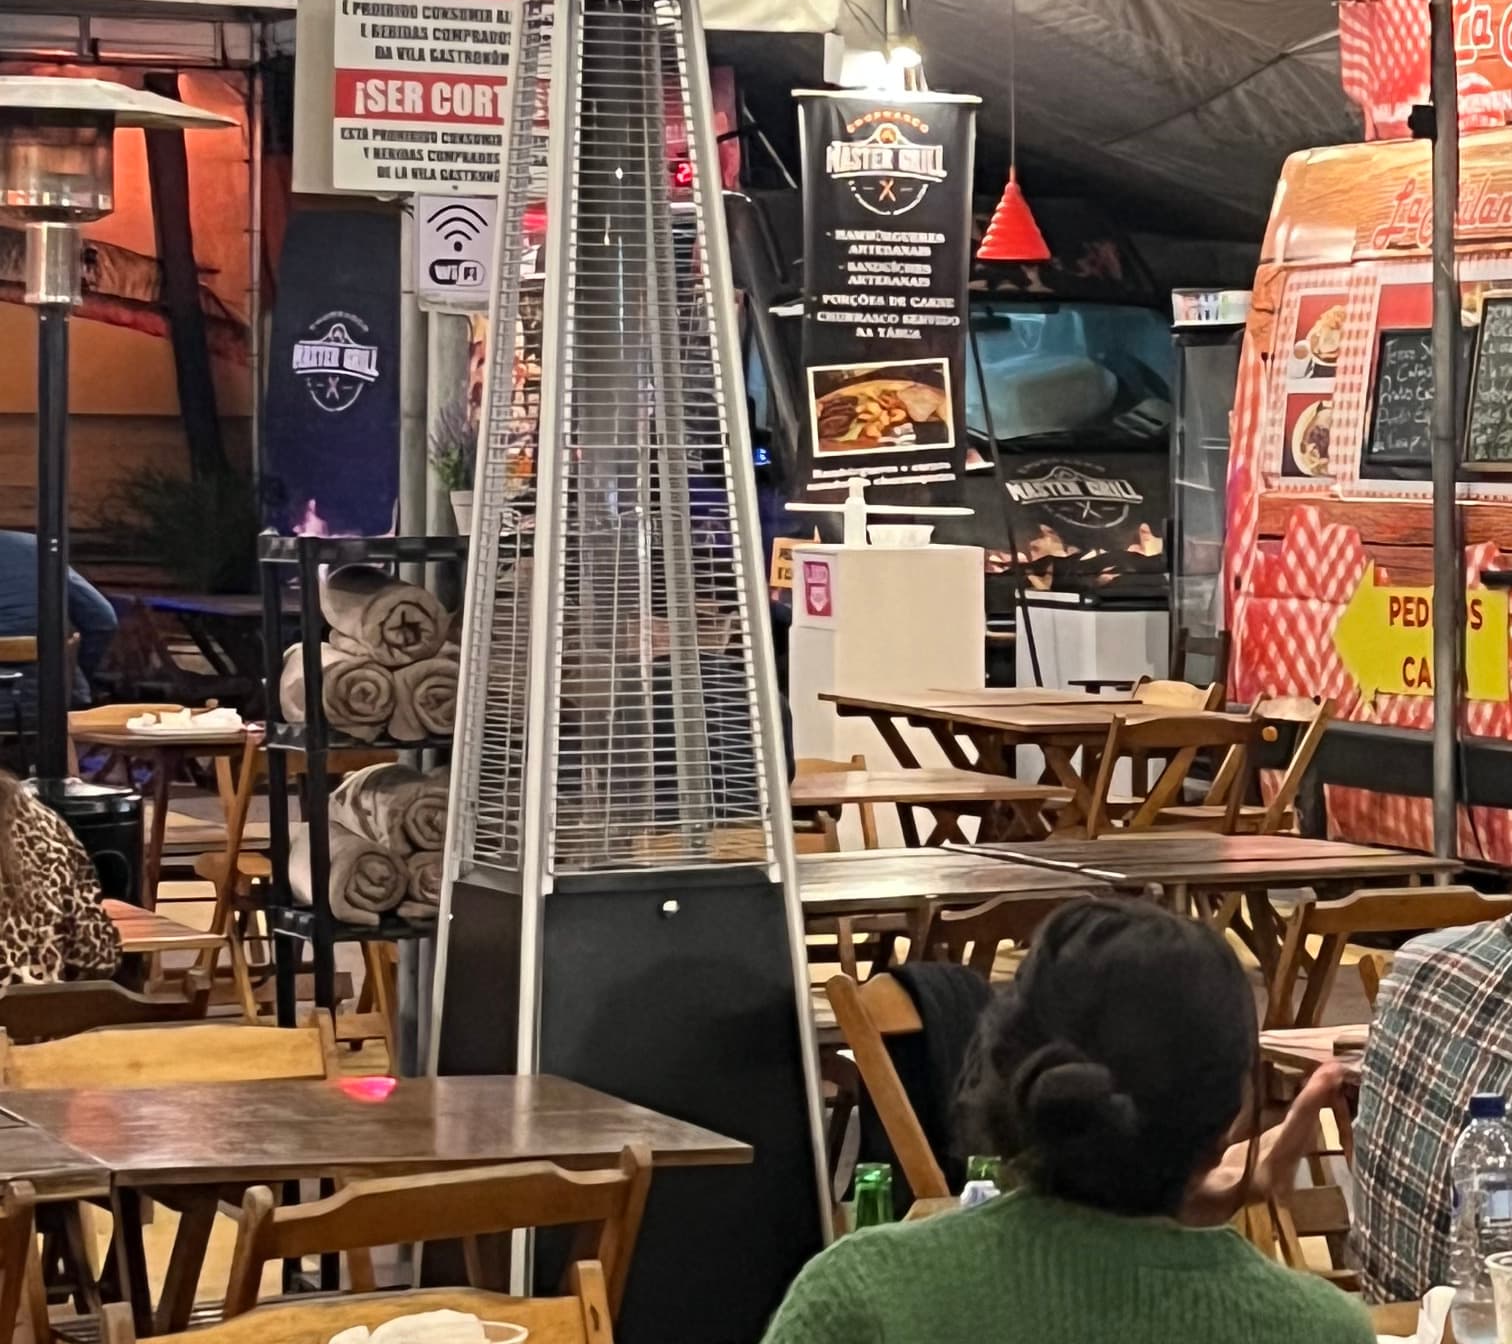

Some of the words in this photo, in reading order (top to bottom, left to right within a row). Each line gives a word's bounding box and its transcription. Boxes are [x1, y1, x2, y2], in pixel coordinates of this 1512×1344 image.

[431, 82, 503, 118] CORT
[826, 143, 894, 173] MASTER
[1389, 595, 1483, 631] PEDS
